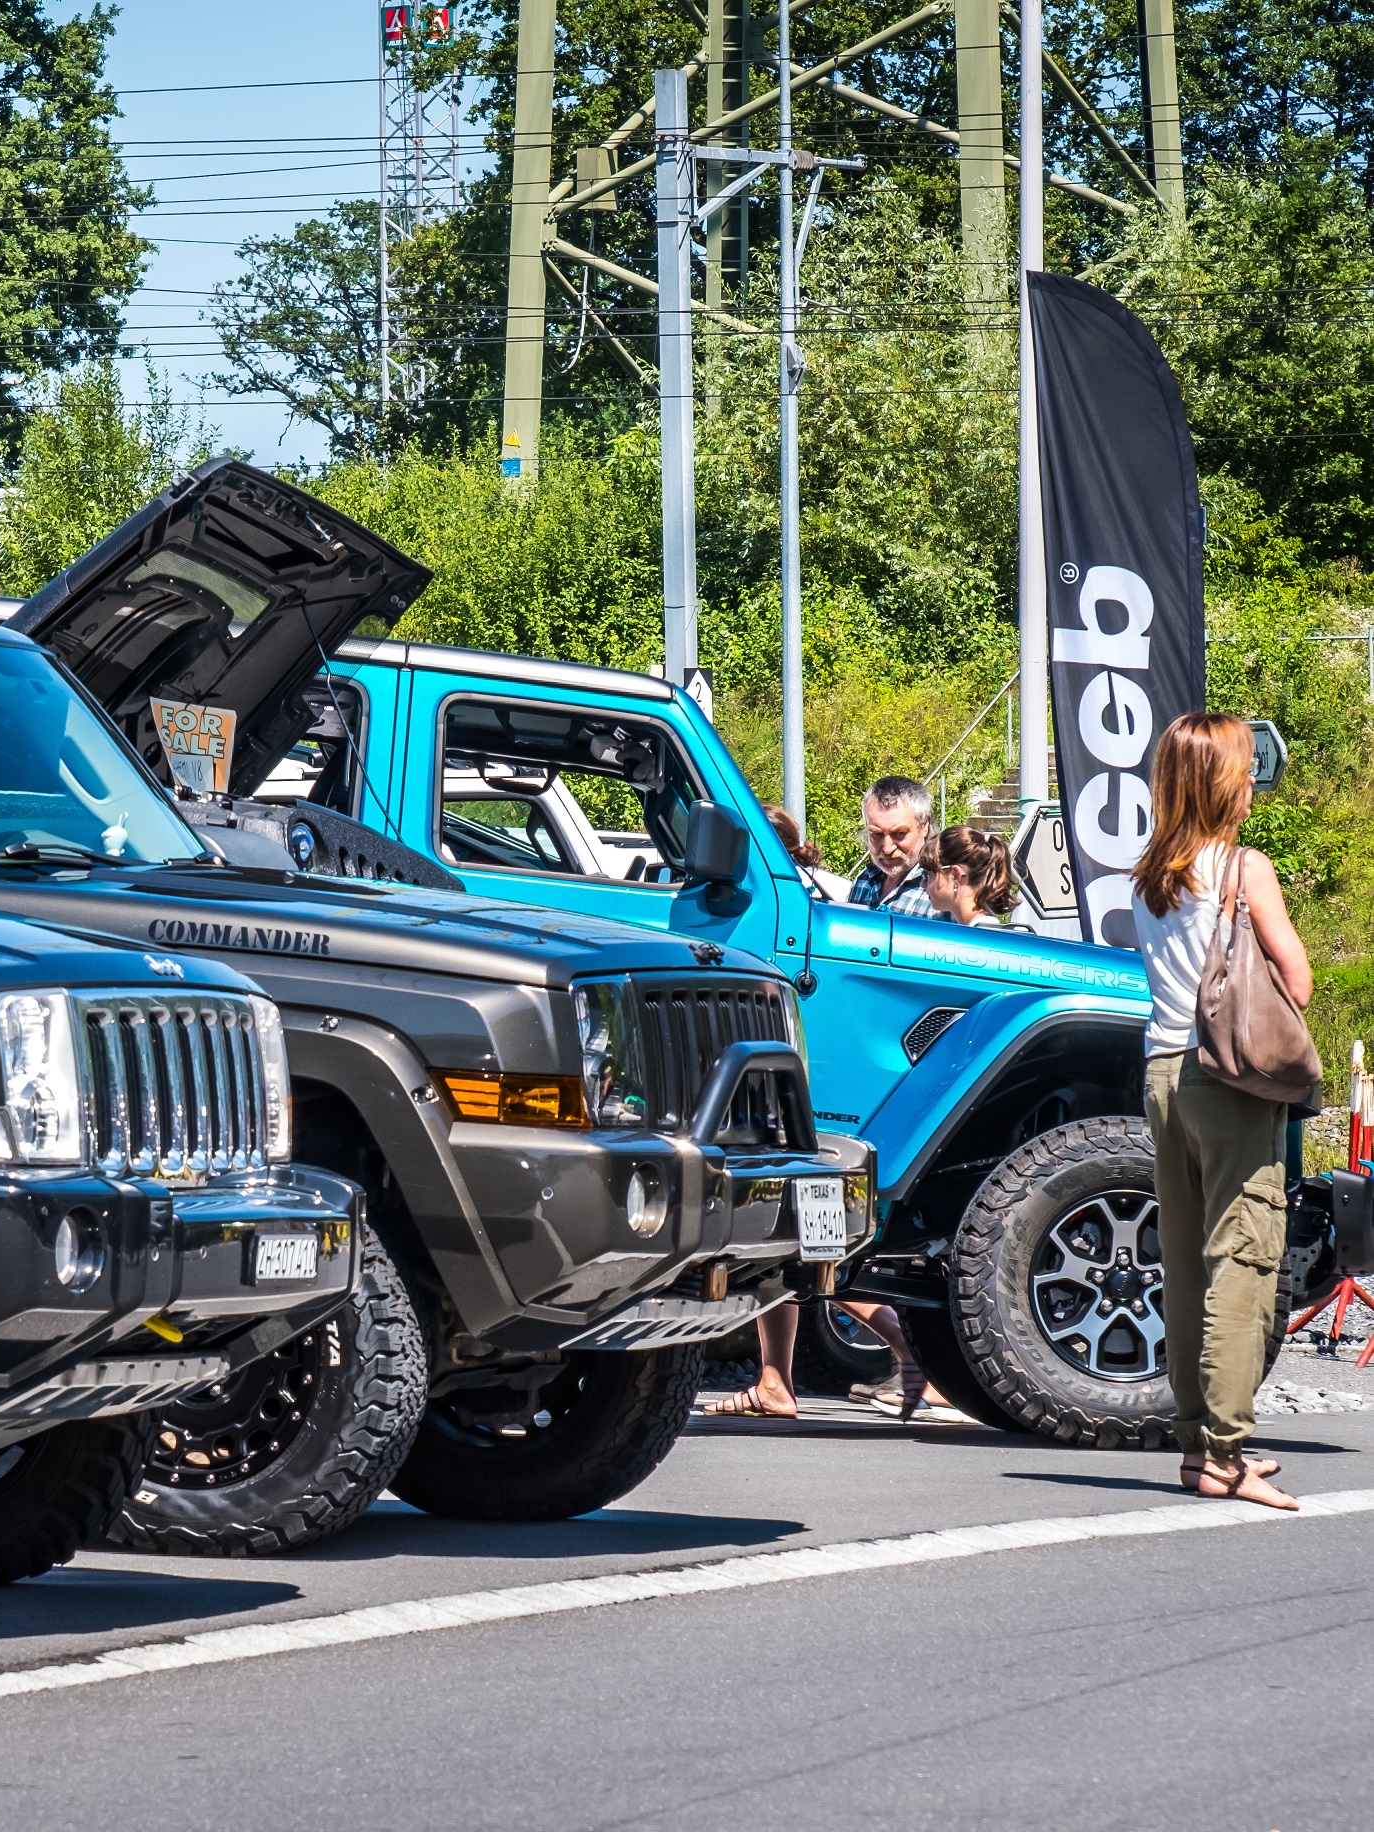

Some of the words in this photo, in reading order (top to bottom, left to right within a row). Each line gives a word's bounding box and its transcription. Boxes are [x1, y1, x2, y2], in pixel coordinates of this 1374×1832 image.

[161, 706, 223, 737] FOR
[160, 727, 226, 759] SALE
[148, 919, 331, 955] COMMANDER
[924, 941, 1149, 994] MOTHERS
[812, 1110, 861, 1125] NDER
[810, 1184, 829, 1199] TEXAS
[327, 1320, 341, 1367] T/A
